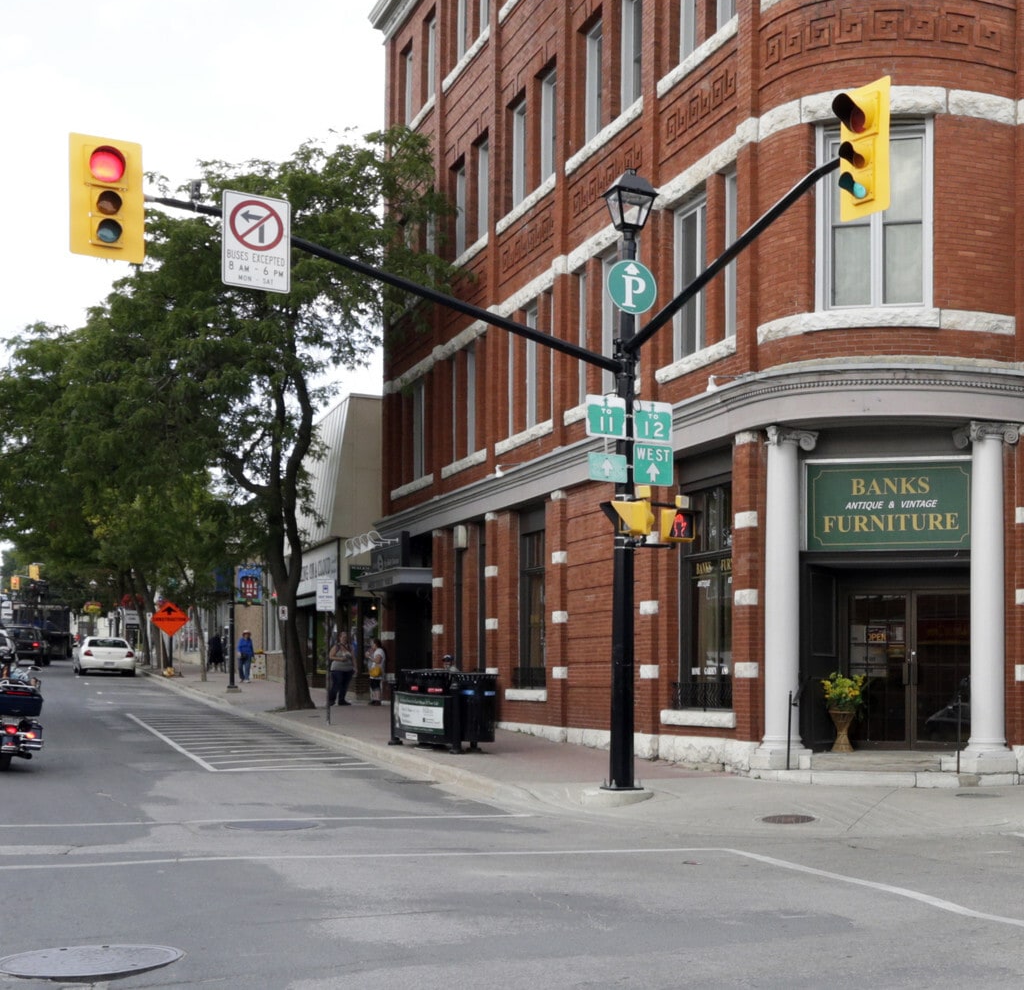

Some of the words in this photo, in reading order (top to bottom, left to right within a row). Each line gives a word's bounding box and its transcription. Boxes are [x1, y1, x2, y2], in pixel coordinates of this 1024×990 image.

[227, 249, 248, 261] BUSES
[252, 254, 285, 267] EXCEPTED
[229, 261, 234, 270] 8
[239, 264, 249, 272] AM
[263, 266, 268, 276] 6
[274, 270, 284, 278] PM
[238, 274, 252, 282] MON
[622, 274, 646, 308] P
[600, 416, 613, 432] 11
[645, 421, 664, 438] 12
[636, 447, 670, 462] WEST
[851, 477, 930, 496] BANKS
[845, 501, 884, 510] ANTIQUE
[888, 501, 895, 509] &
[901, 499, 938, 509] VINTAGE
[823, 512, 960, 533] FURNITURE
